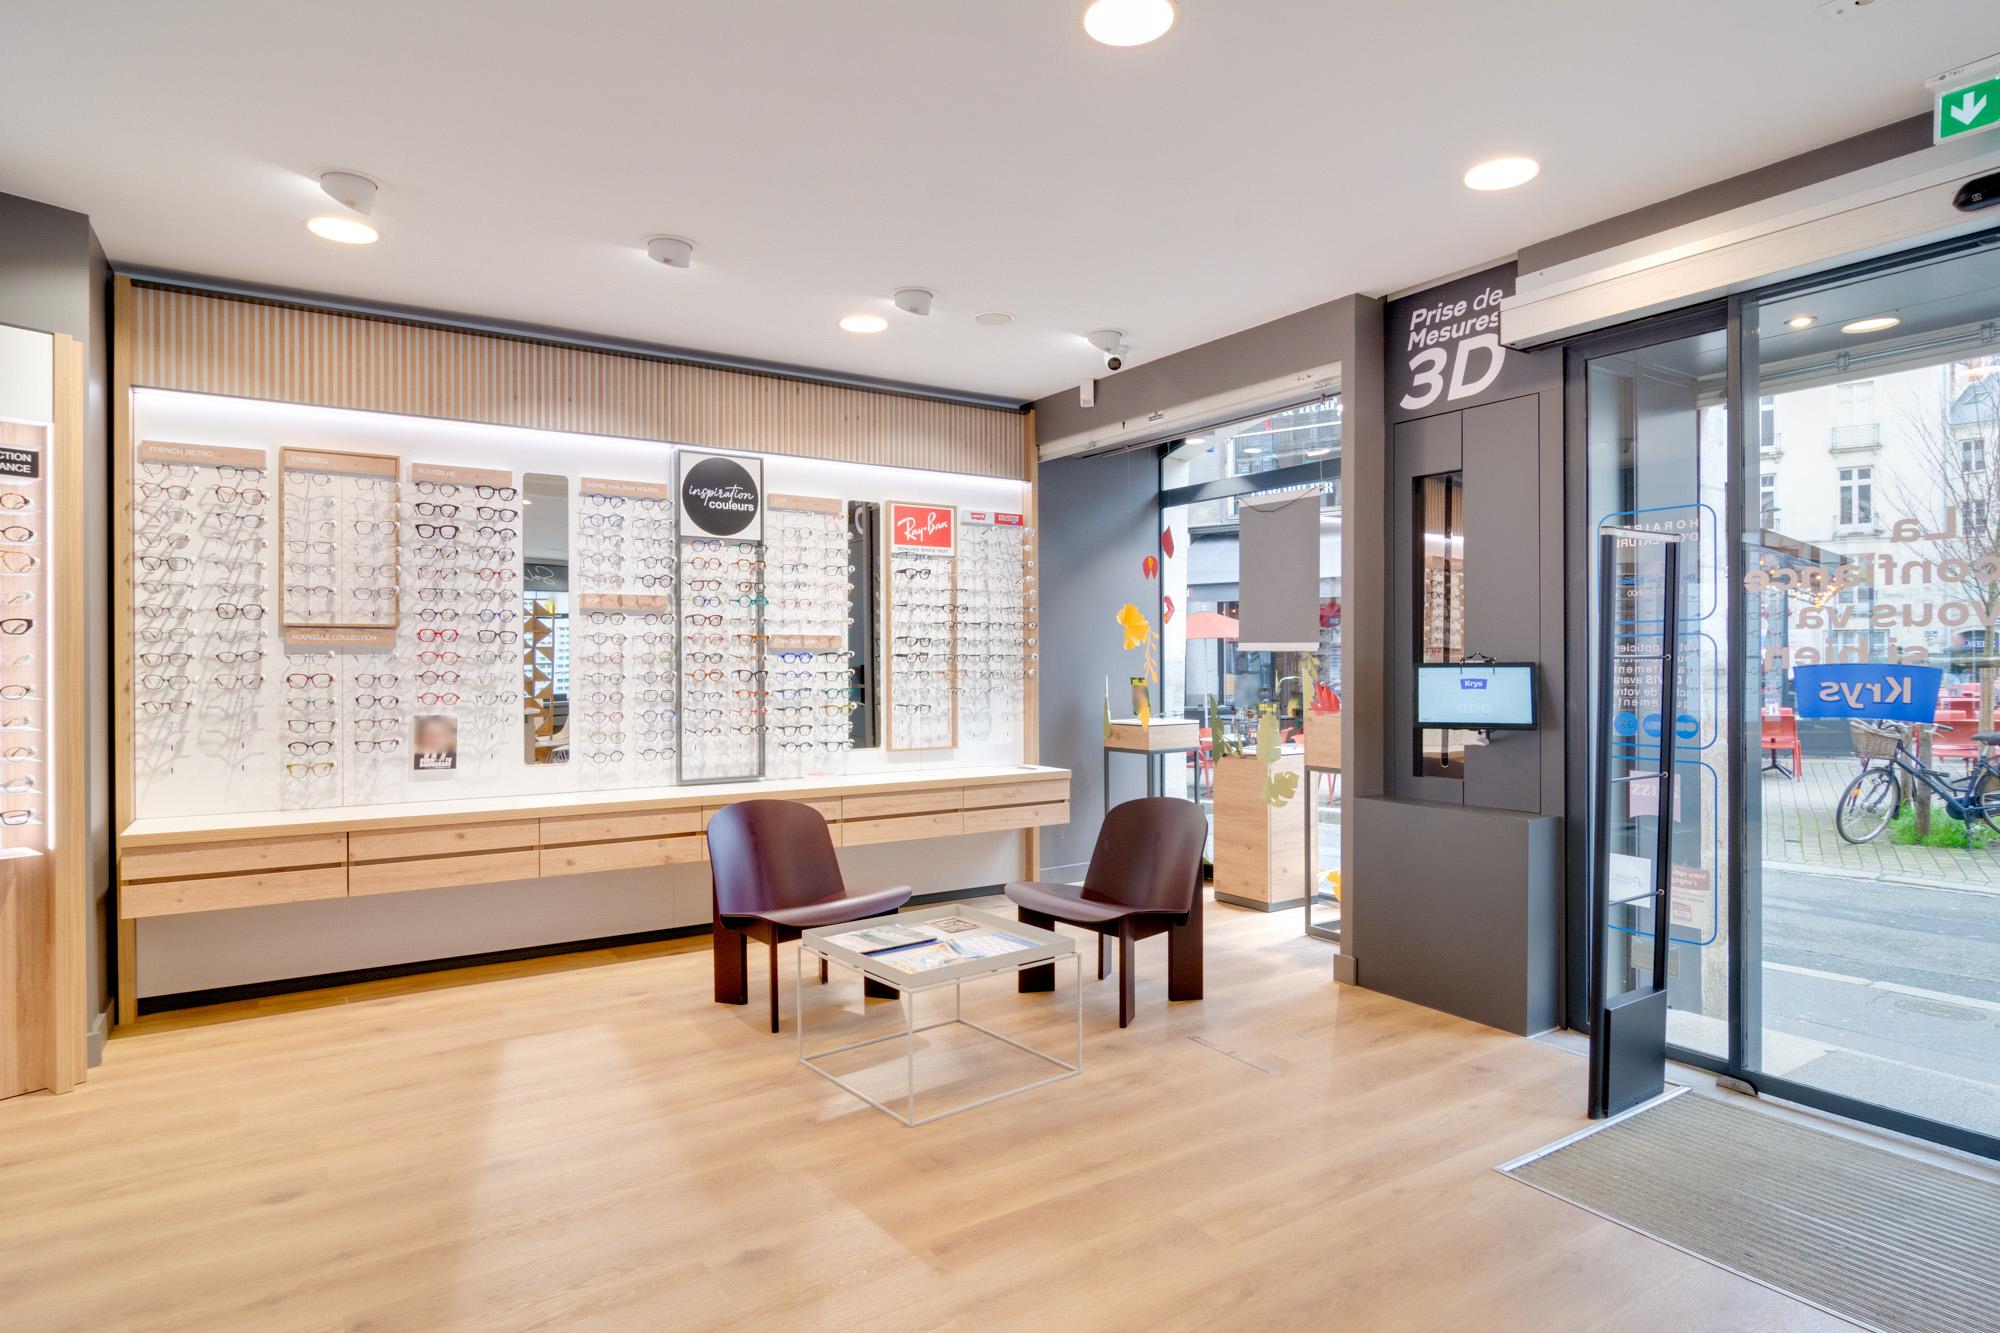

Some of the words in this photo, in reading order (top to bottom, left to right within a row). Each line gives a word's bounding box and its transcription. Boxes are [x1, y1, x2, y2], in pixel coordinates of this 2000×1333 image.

[1409, 299, 1467, 331] Prise
[1473, 287, 1503, 310] de
[1407, 311, 1499, 351] Mesures
[1400, 333, 1506, 410] 3D
[0, 451, 32, 462] CTION
[0, 462, 32, 474] ANCE
[688, 484, 754, 507] inspiration
[708, 500, 755, 512] couleurs
[896, 511, 949, 542] Ray-Ban
[292, 633, 332, 641] NOUVELLE
[333, 633, 377, 641] COLLECTION
[1464, 680, 1483, 688] Krys
